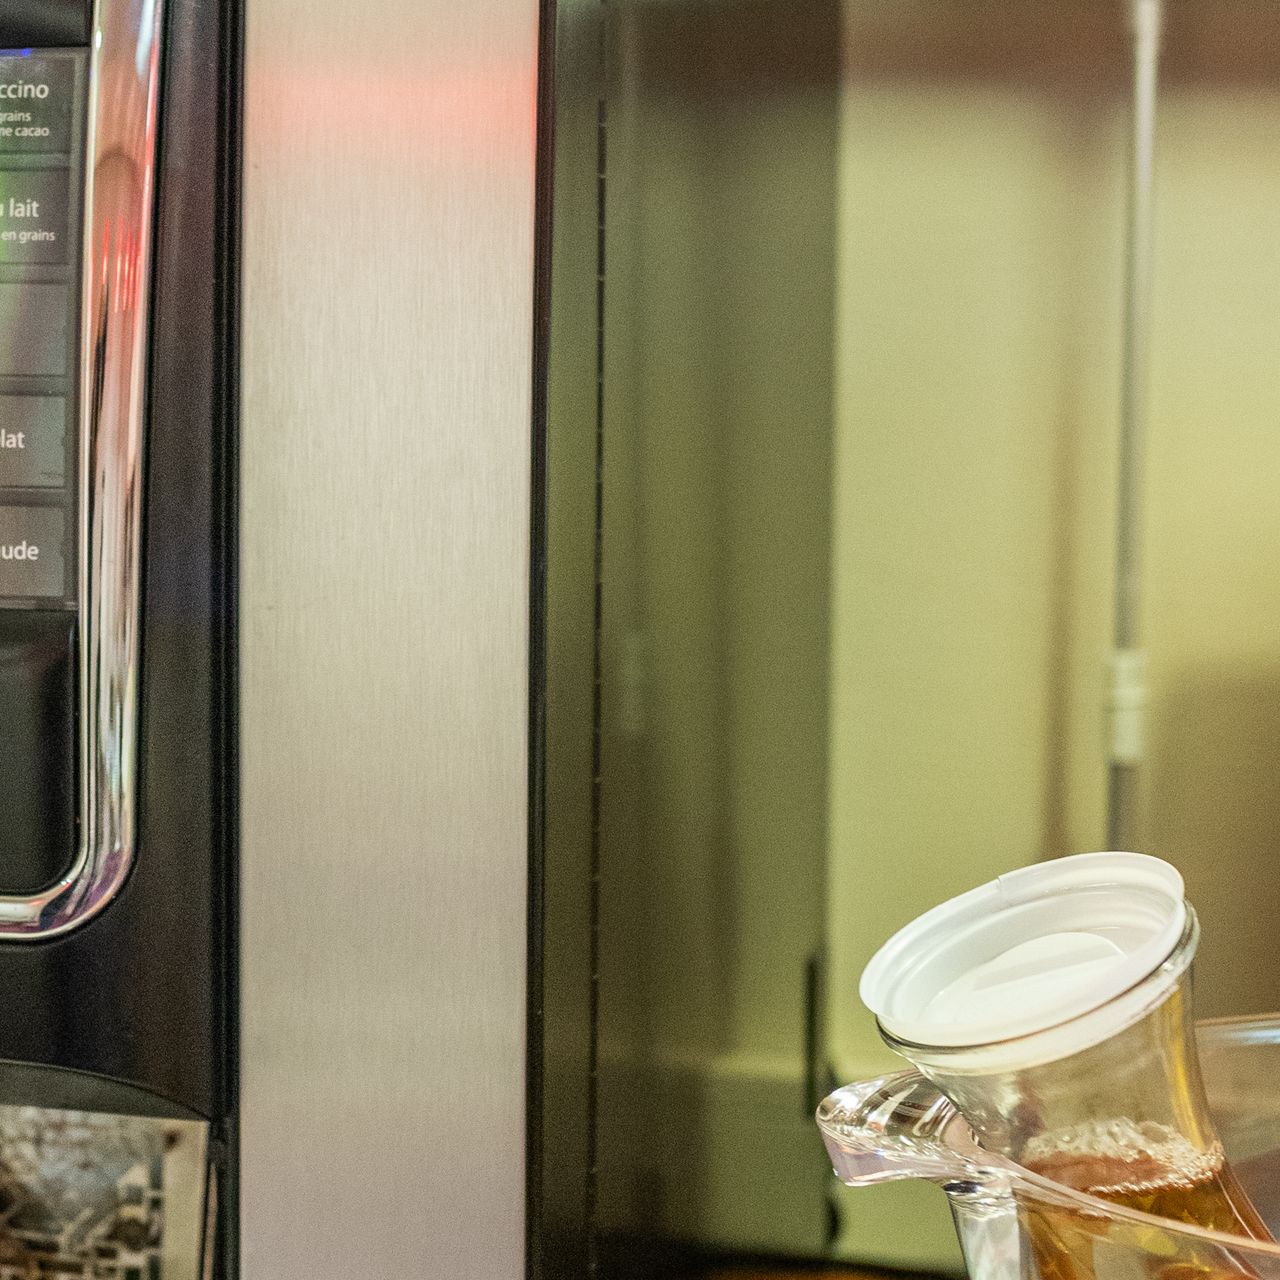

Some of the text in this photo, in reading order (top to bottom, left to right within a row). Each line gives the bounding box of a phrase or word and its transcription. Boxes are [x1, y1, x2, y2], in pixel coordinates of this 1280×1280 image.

[14, 127, 50, 136] cacao
[9, 198, 39, 218] lait
[1, 230, 17, 240] en
[18, 229, 56, 244] grains
